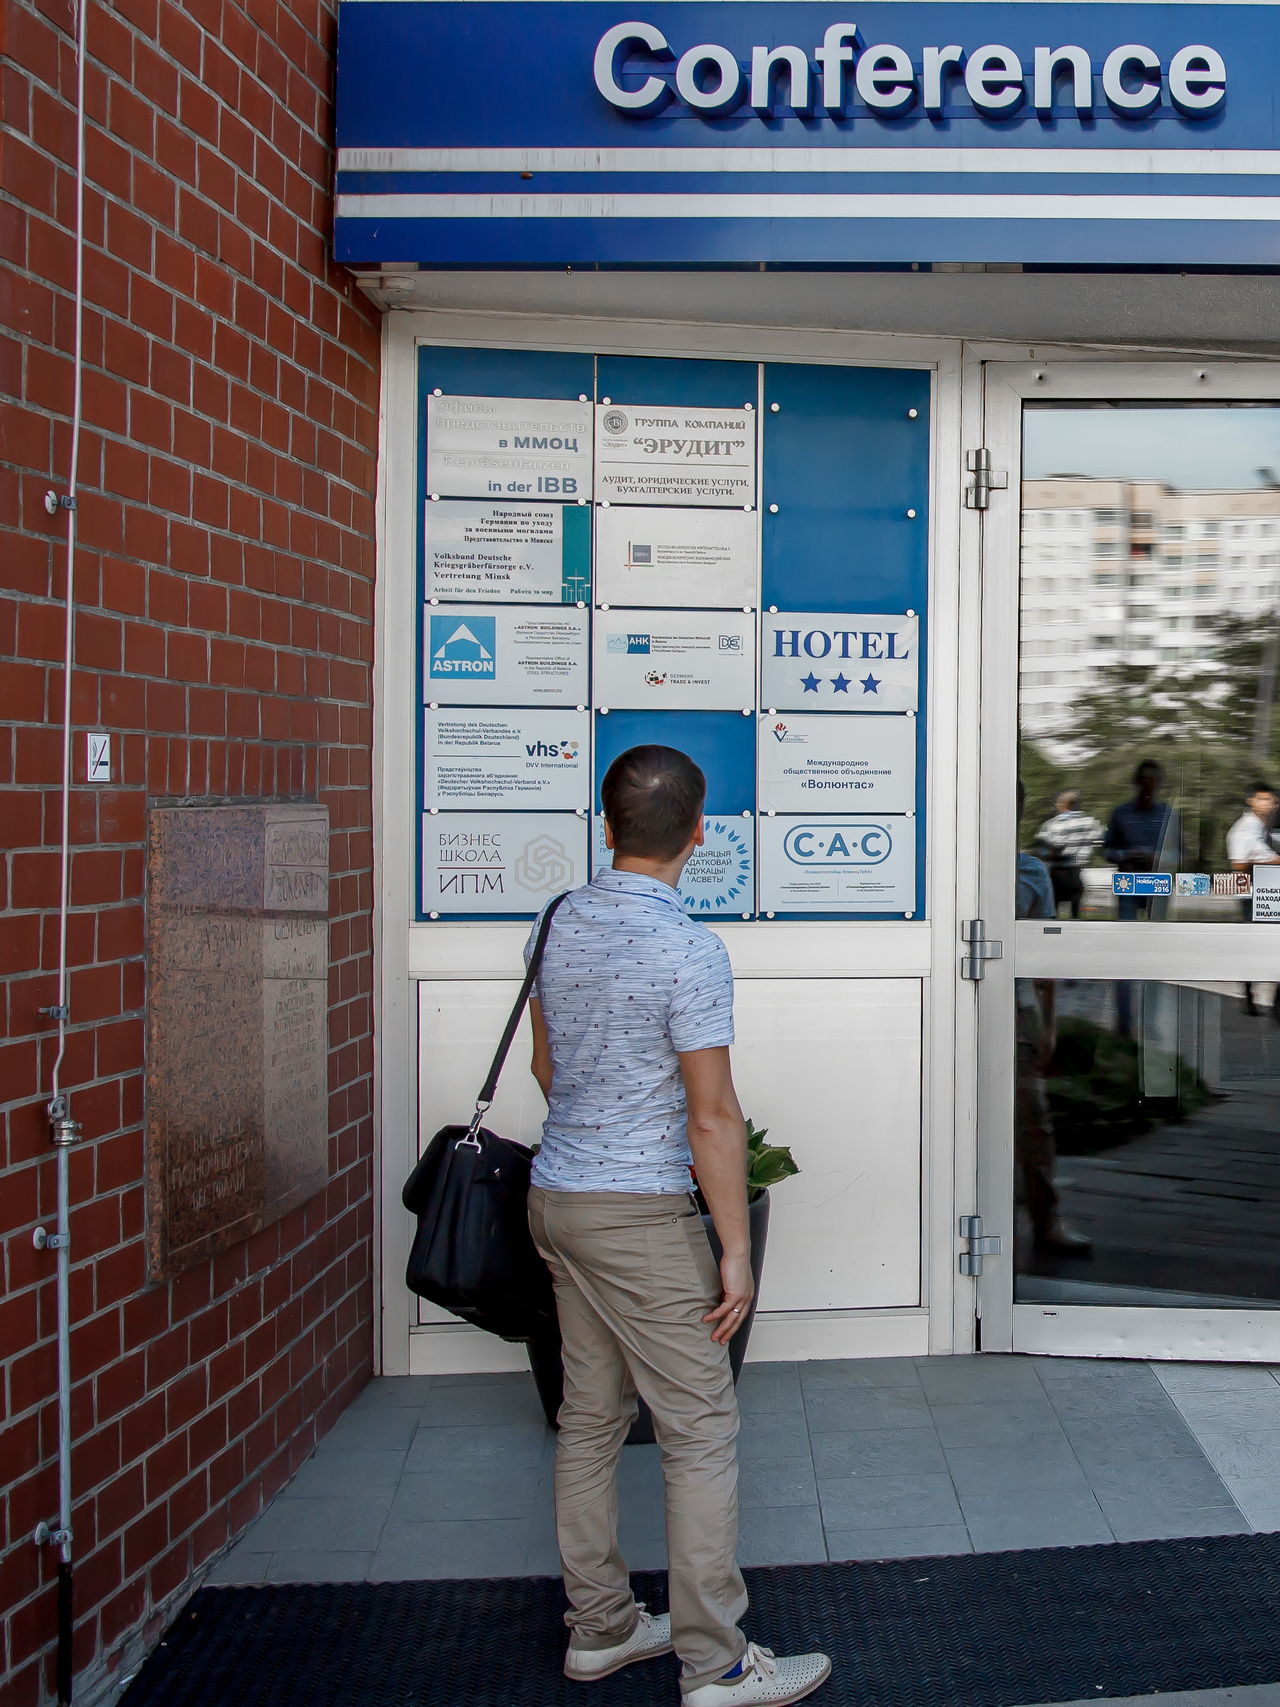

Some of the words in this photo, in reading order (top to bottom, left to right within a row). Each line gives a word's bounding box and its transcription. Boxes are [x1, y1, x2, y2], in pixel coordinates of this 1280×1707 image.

[594, 20, 1227, 116] Conference
[436, 400, 496, 414] Офисы
[436, 418, 586, 433] представительств
[635, 418, 679, 428] ГРУППА
[685, 420, 746, 429] КОМПАНИЙ
[499, 440, 508, 448] в
[514, 436, 578, 452] ММОЦ
[444, 455, 570, 470] Repräsentanzen
[488, 480, 502, 492] in
[507, 481, 532, 492] der
[538, 477, 578, 493] IBB
[602, 476, 636, 485] АУДИТ,
[638, 477, 709, 486] ЮРИДИЧЕСКИЕ
[711, 479, 749, 487] УСЛУГИ,
[617, 486, 692, 495] БУХГАЛТЕРСКИЕ
[697, 488, 735, 496] УСЛУГИ.
[493, 510, 532, 518] Народный
[481, 518, 518, 526] Германии
[464, 536, 523, 544] Представительство
[434, 562, 517, 570] Kriegsgräberfürsorge
[434, 572, 482, 580] Vertretung
[629, 637, 649, 645] AHK
[772, 629, 909, 659] HOTEL
[432, 660, 493, 672] ASTRON
[525, 741, 559, 757] vhs
[807, 759, 869, 767] Международное
[801, 780, 874, 789] «Волюнтас»
[439, 833, 501, 846] БИЗНЕС
[439, 850, 502, 862] ШКОЛА
[684, 858, 732, 866] АДАТКОВАЙ
[440, 873, 504, 894] ИПМ
